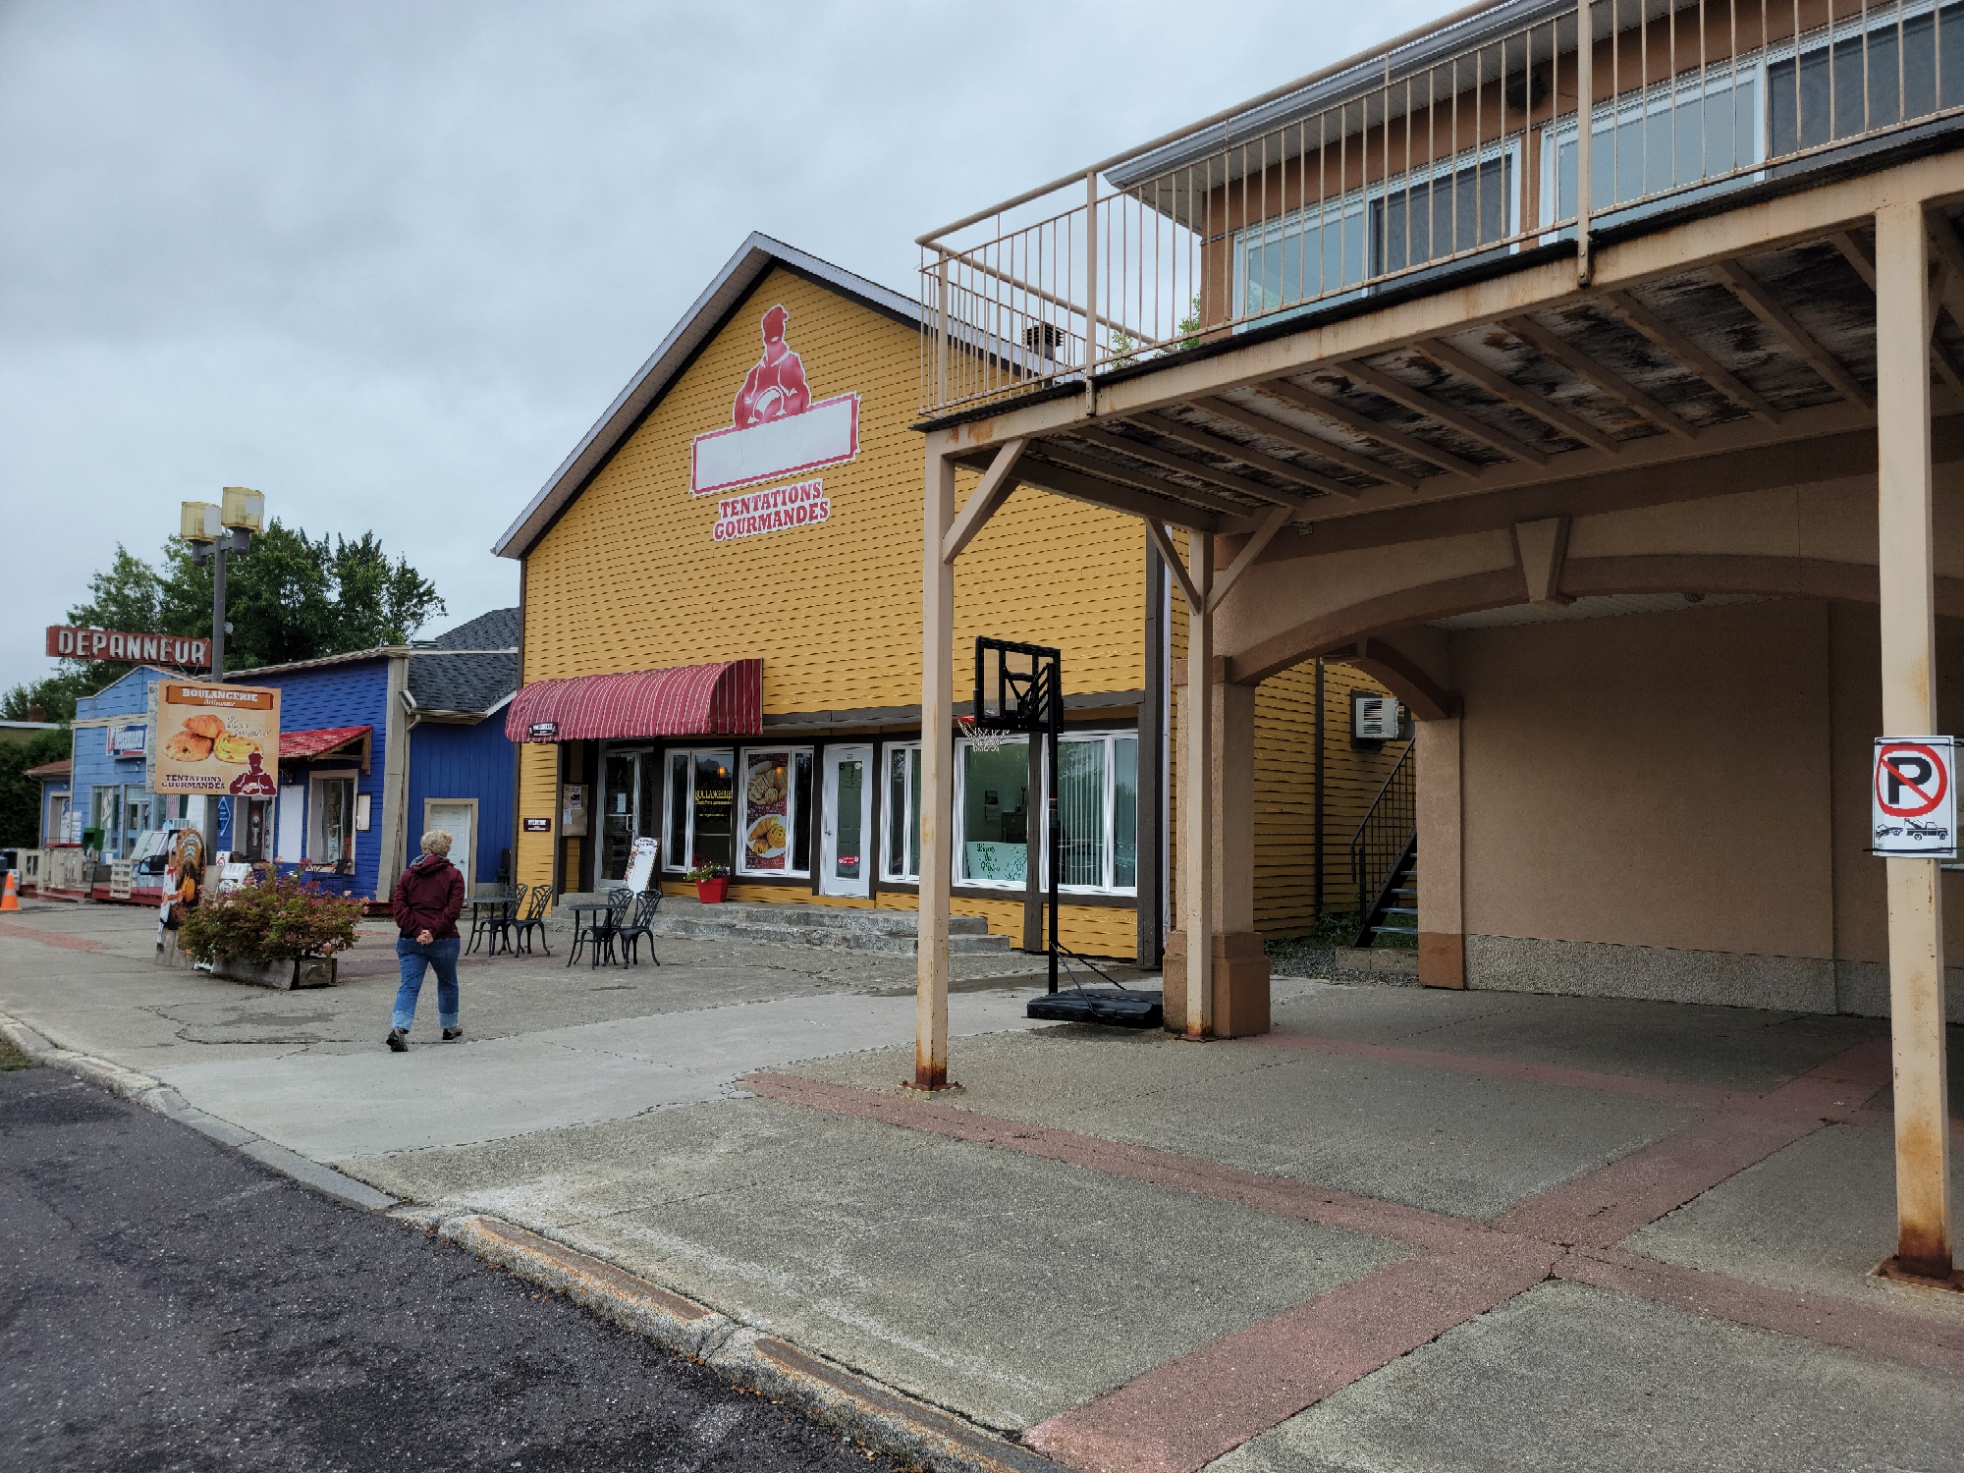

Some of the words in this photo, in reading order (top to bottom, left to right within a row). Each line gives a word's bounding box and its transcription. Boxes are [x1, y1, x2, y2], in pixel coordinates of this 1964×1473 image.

[720, 482, 821, 519] TENTATIONS
[714, 502, 829, 539] GOURMANDES
[58, 629, 205, 665] DEPANNEUR
[182, 688, 258, 702] BOULANGERIE
[161, 781, 226, 790] GOURMANDES
[165, 774, 222, 783] TENTATIONS
[1888, 757, 1932, 804] P
